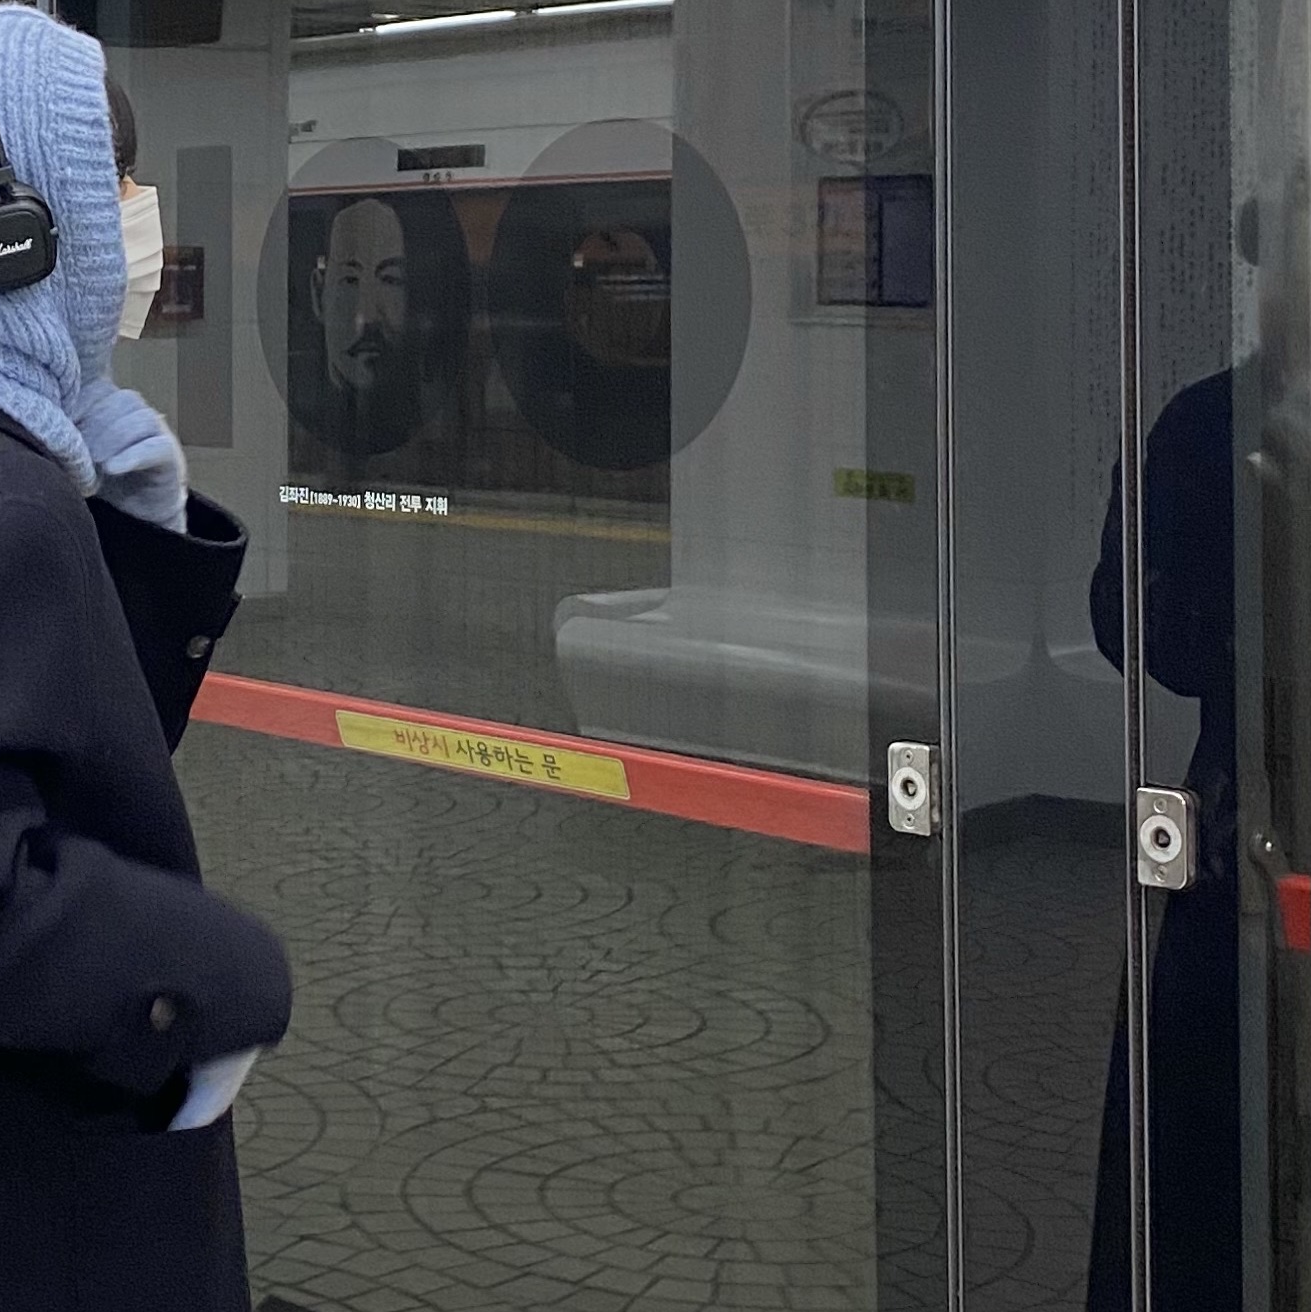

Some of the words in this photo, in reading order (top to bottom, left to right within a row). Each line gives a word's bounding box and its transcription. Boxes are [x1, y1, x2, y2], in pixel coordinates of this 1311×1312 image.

[363, 491, 396, 512] 청산리
[399, 494, 422, 514] 전투
[424, 496, 449, 516] 지휘
[392, 727, 451, 760] 비상시
[455, 737, 535, 776] 사용하는
[541, 752, 562, 781] 문
